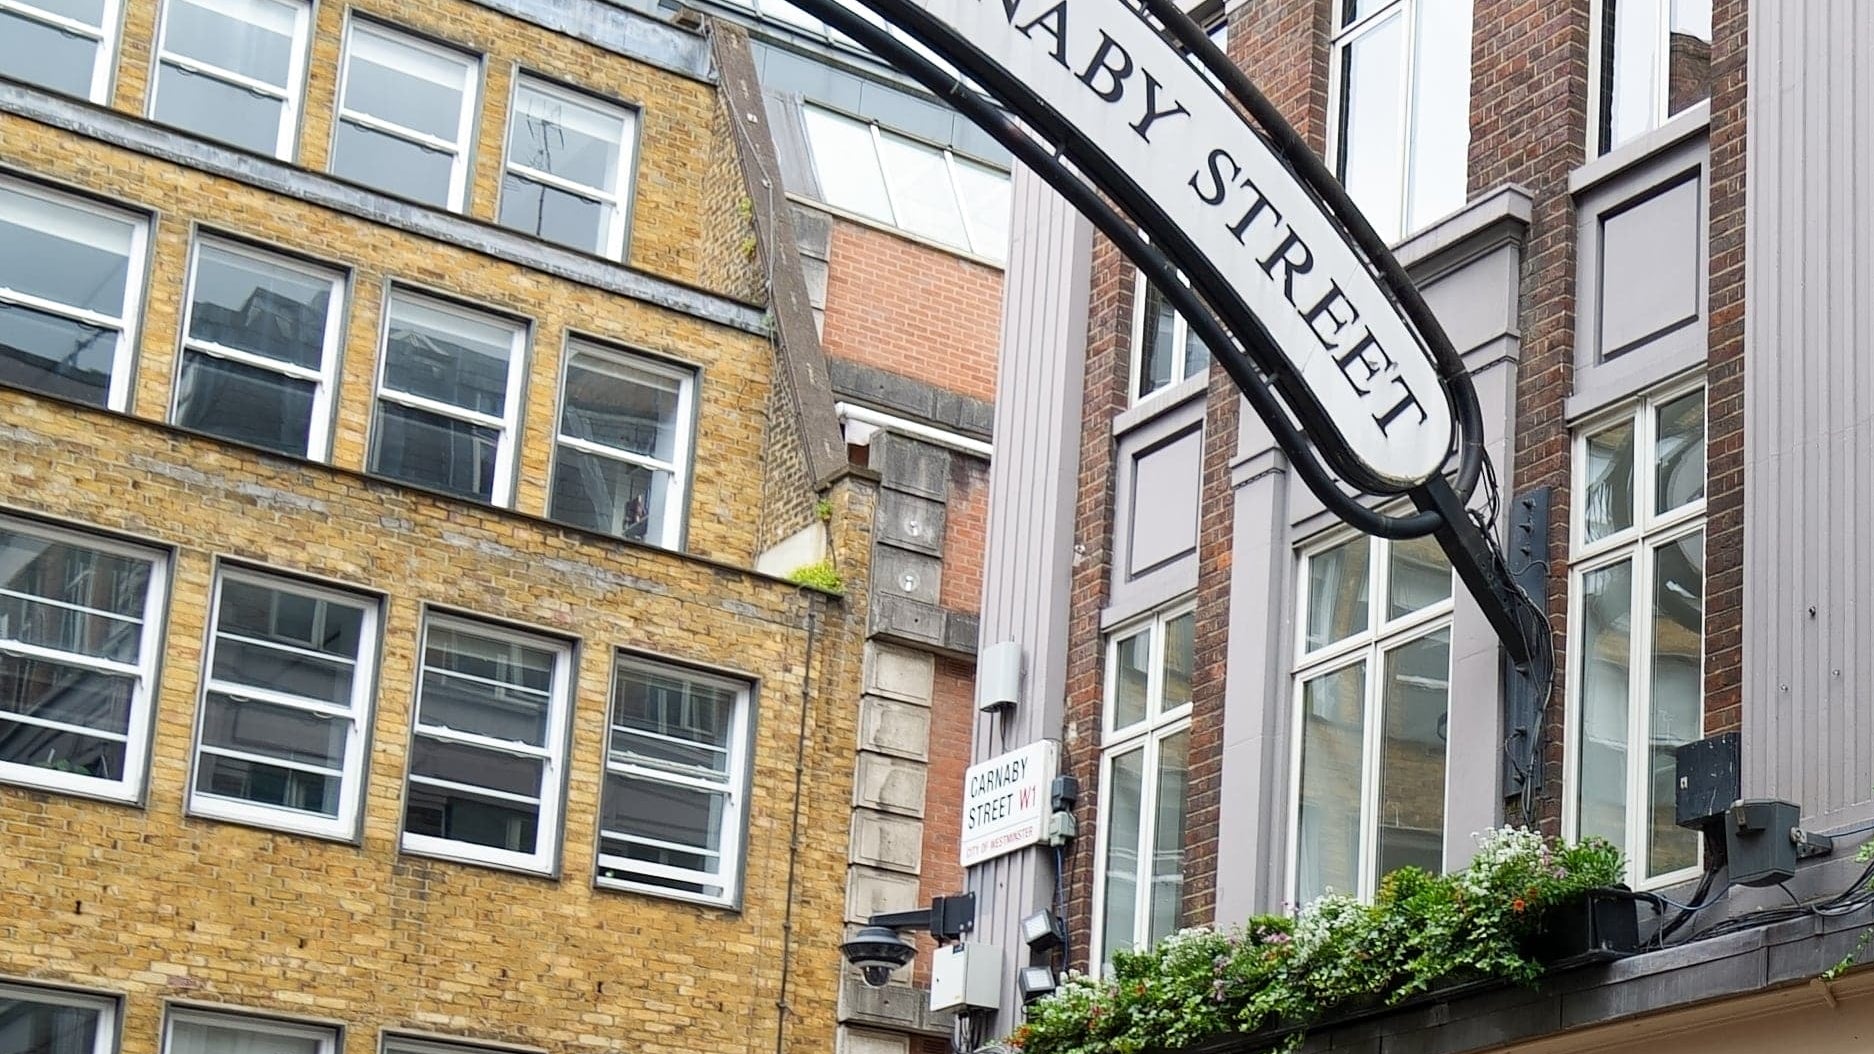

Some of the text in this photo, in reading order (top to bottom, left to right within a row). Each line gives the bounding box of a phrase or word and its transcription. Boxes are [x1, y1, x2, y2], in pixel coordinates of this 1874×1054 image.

[1188, 149, 1428, 439] STREET
[971, 757, 1028, 798] CARNABY
[968, 785, 1036, 830] STREET W1
[966, 826, 1034, 859] CITY OF WESTMINSTER
